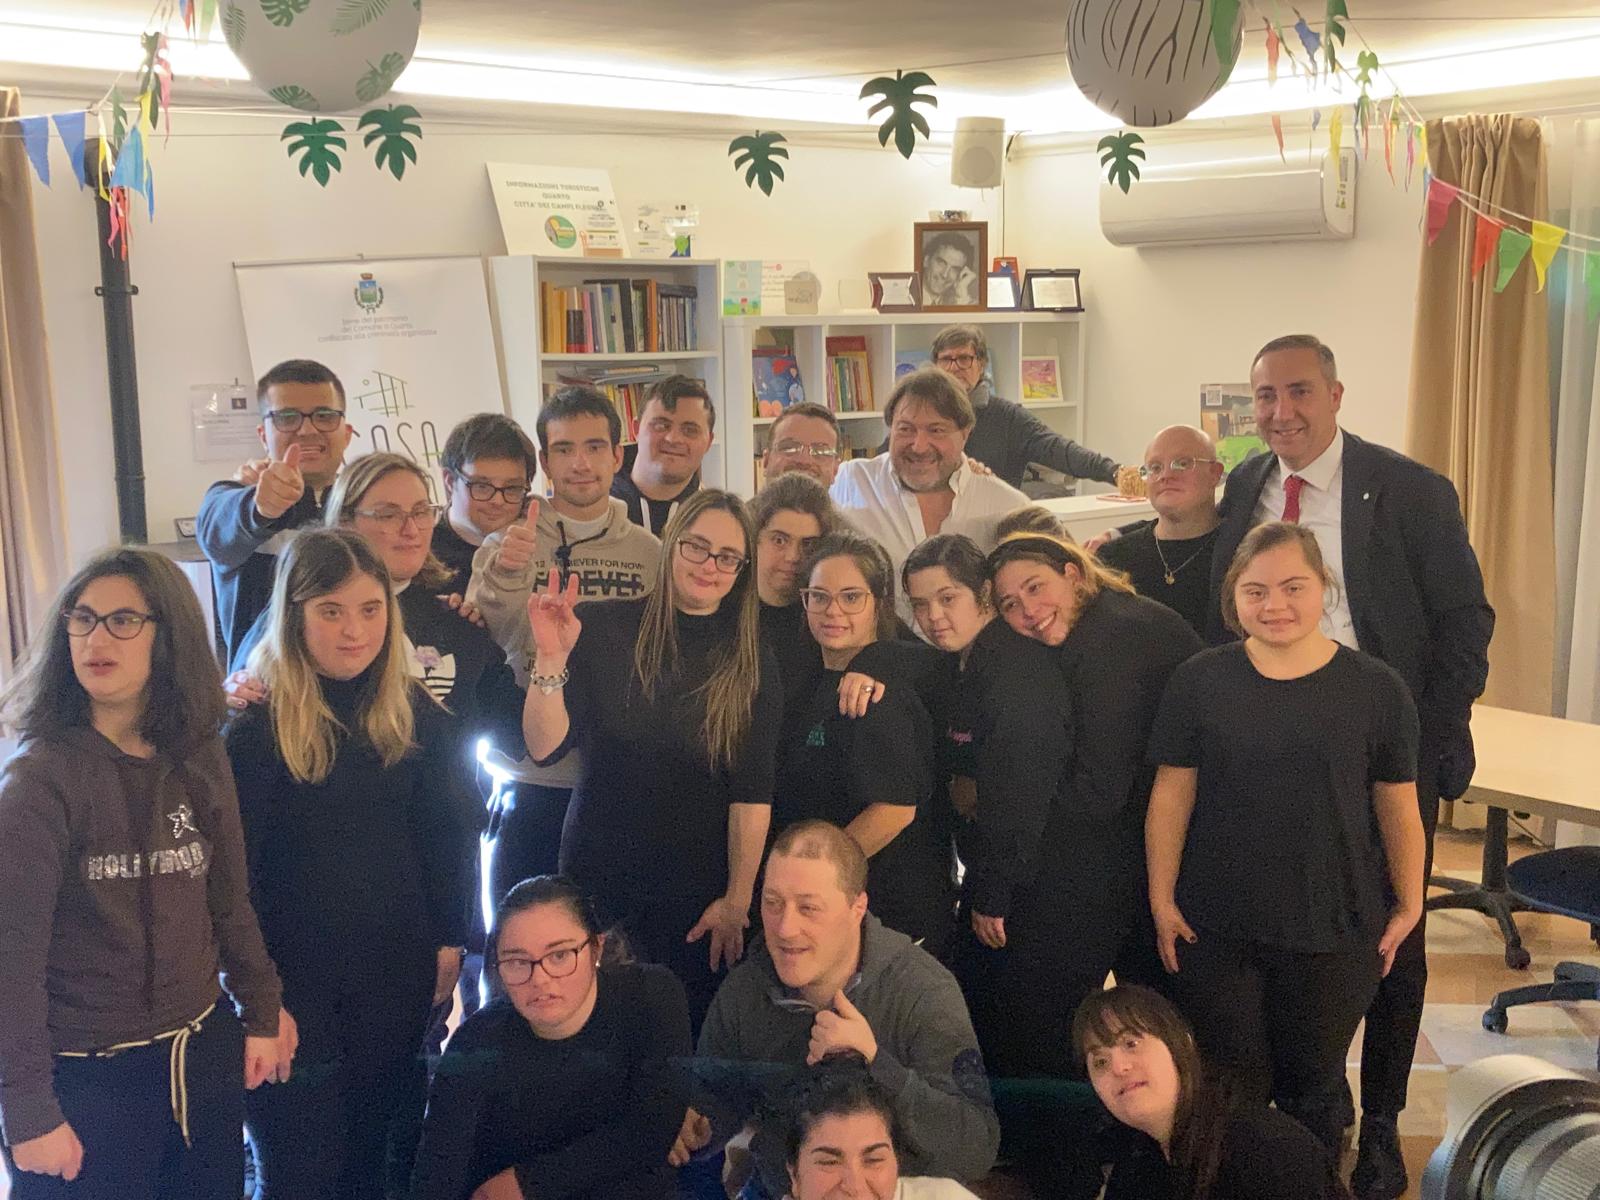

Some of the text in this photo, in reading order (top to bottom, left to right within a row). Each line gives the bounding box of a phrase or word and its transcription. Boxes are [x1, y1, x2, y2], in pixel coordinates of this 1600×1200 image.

[506, 180, 600, 192] INFORMAZIONI TURISTICHE
[542, 192, 570, 200] QUARTO
[555, 557, 599, 569] FREVER
[599, 558, 620, 569] FOR
